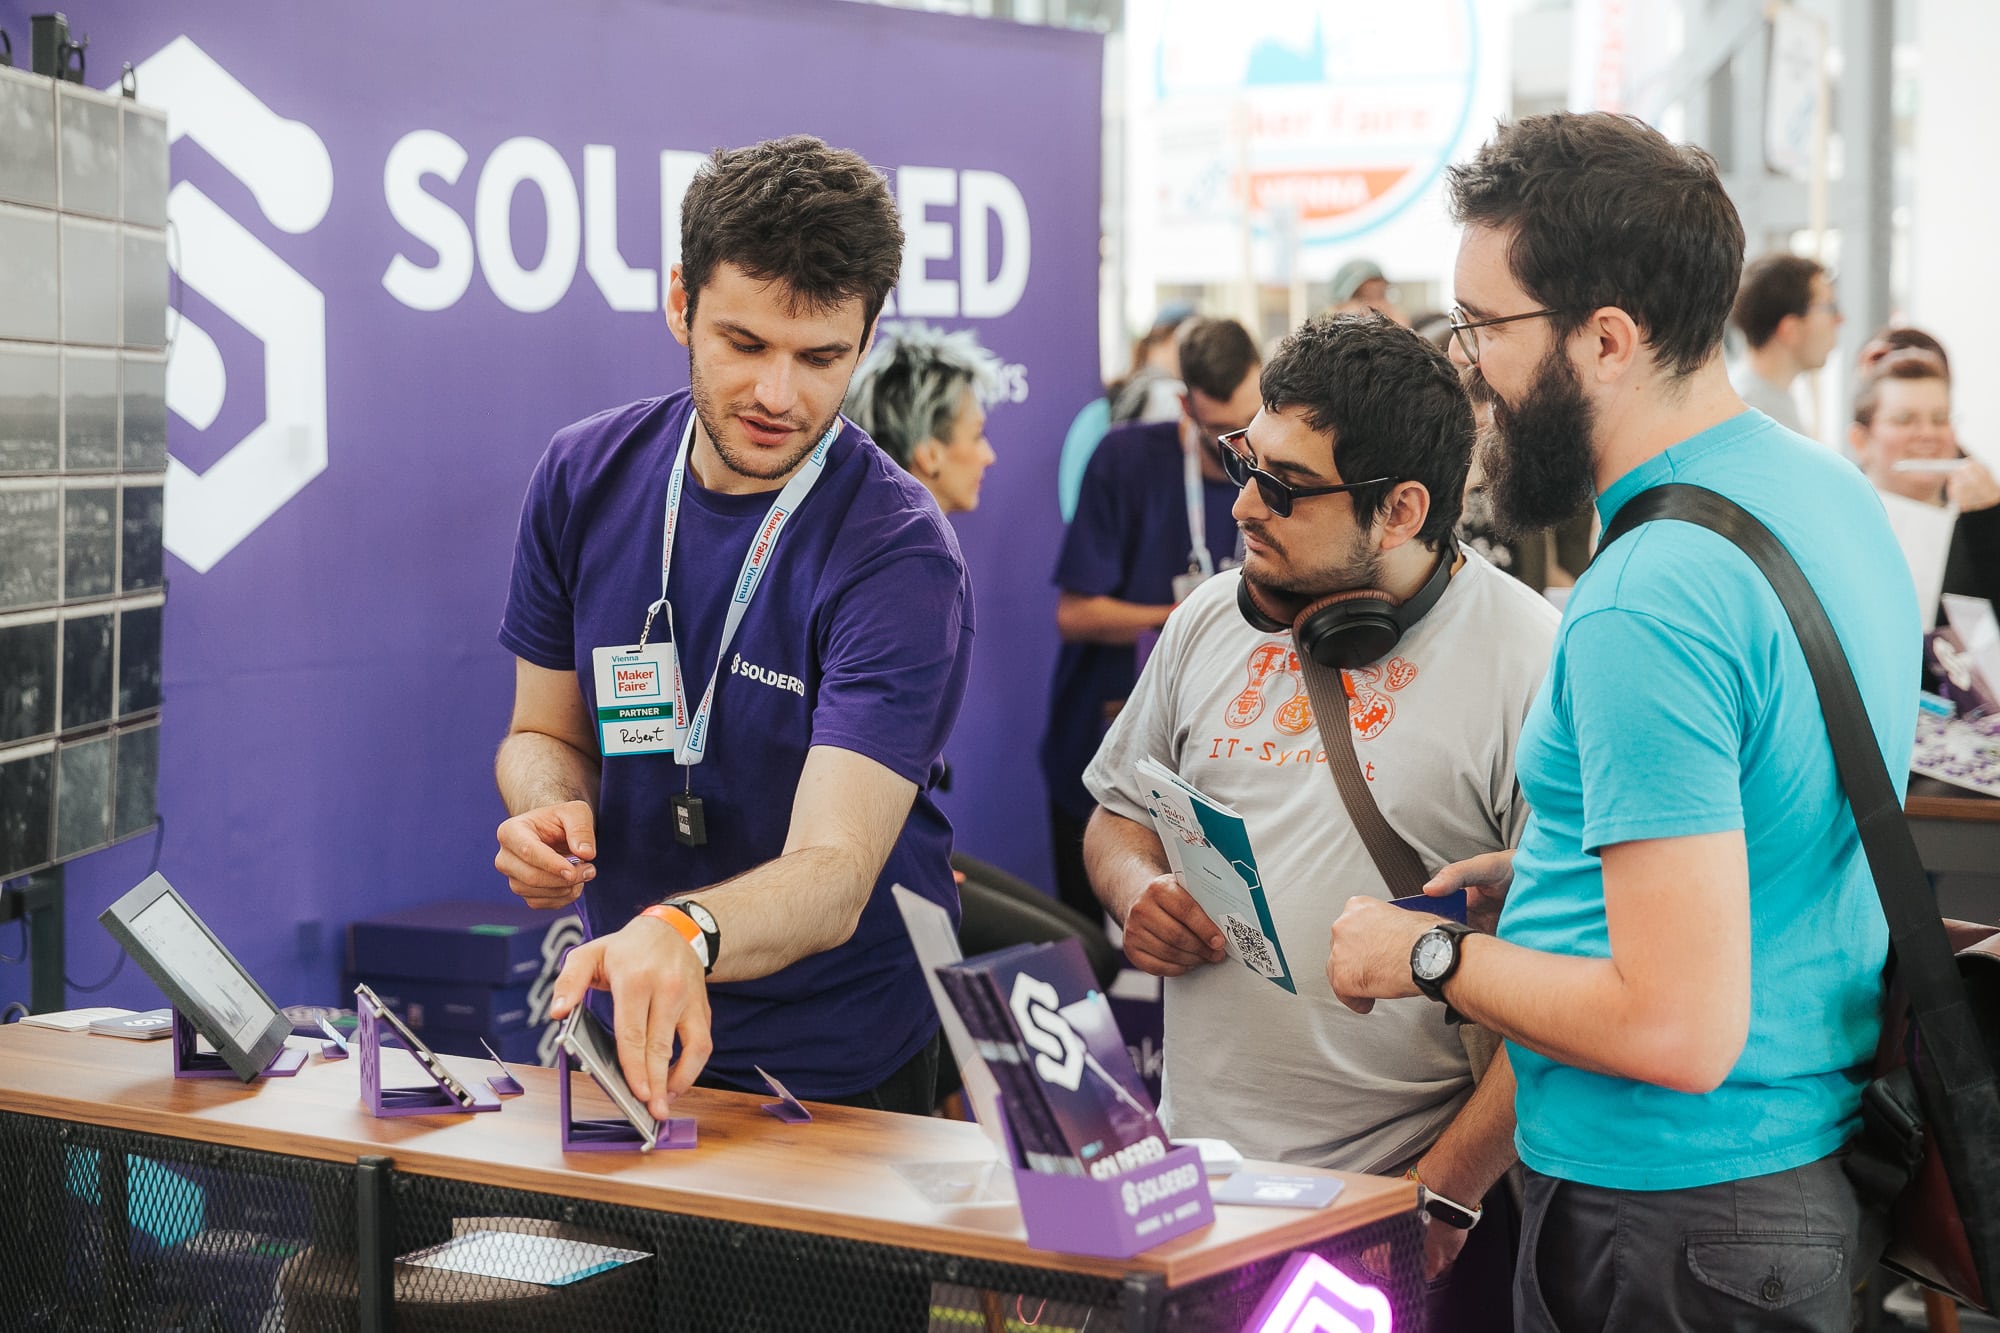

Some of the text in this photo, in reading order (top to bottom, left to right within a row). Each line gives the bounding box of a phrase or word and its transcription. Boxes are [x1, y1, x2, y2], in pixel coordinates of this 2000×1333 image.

[669, 472, 681, 508] Vienna
[739, 510, 785, 600] Maker Faire Vienna
[611, 655, 640, 663] Vienna
[616, 670, 655, 681] Maker
[619, 707, 660, 718] PARTNER
[677, 695, 685, 726] Maker
[619, 726, 665, 745] Robert
[691, 714, 705, 747] Vienna
